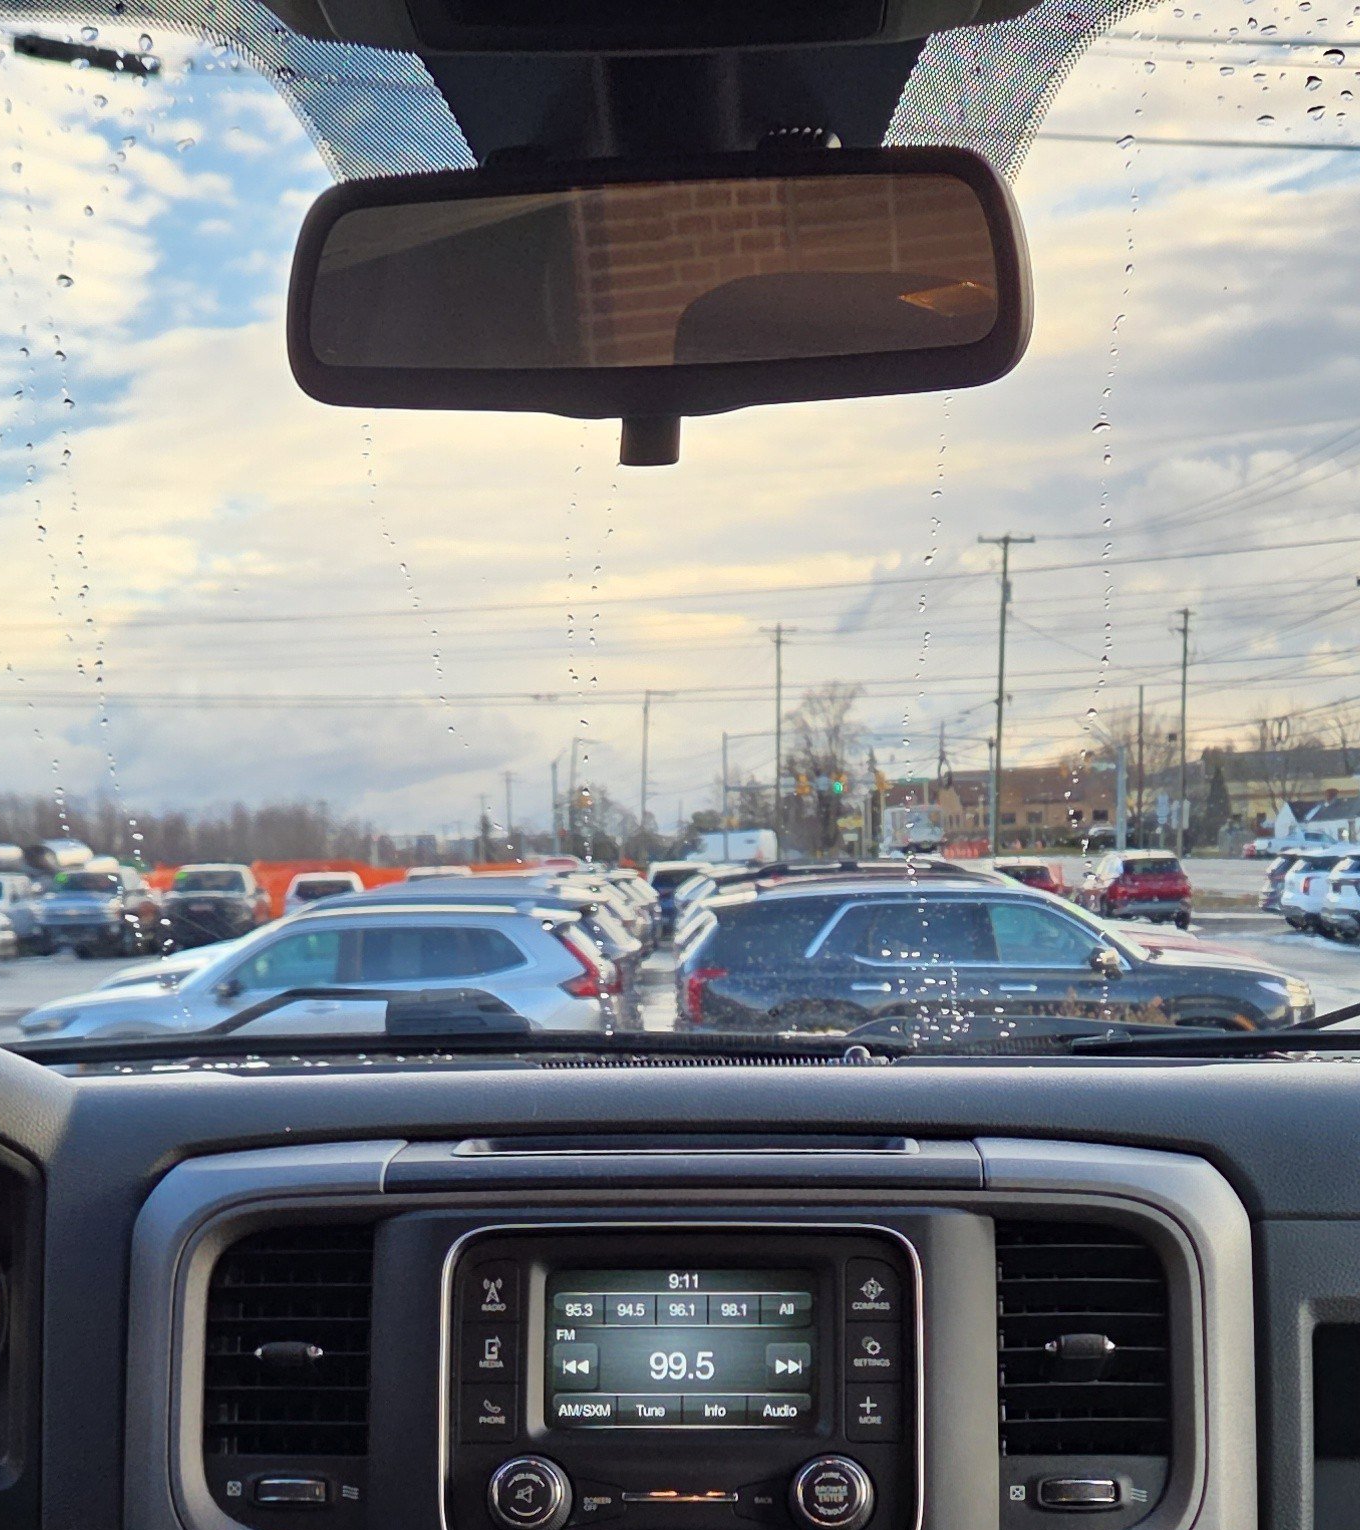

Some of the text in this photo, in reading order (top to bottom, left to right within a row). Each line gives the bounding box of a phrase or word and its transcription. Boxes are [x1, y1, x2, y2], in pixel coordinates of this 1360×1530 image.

[669, 1273, 699, 1289] 9:11
[481, 1303, 507, 1312] RADIO
[565, 1303, 794, 1317] 95.3 94.5 96.1 98.1 All
[852, 1302, 890, 1311] COMPASS
[556, 1329, 575, 1341] FM
[479, 1360, 504, 1368] MEDIA
[649, 1351, 715, 1380] 99.5
[853, 1358, 890, 1367] SETTINGS
[558, 1404, 798, 1418] AM/SXM Tune Info Audio
[479, 1416, 505, 1425] PHONE
[859, 1416, 882, 1425] MORE
